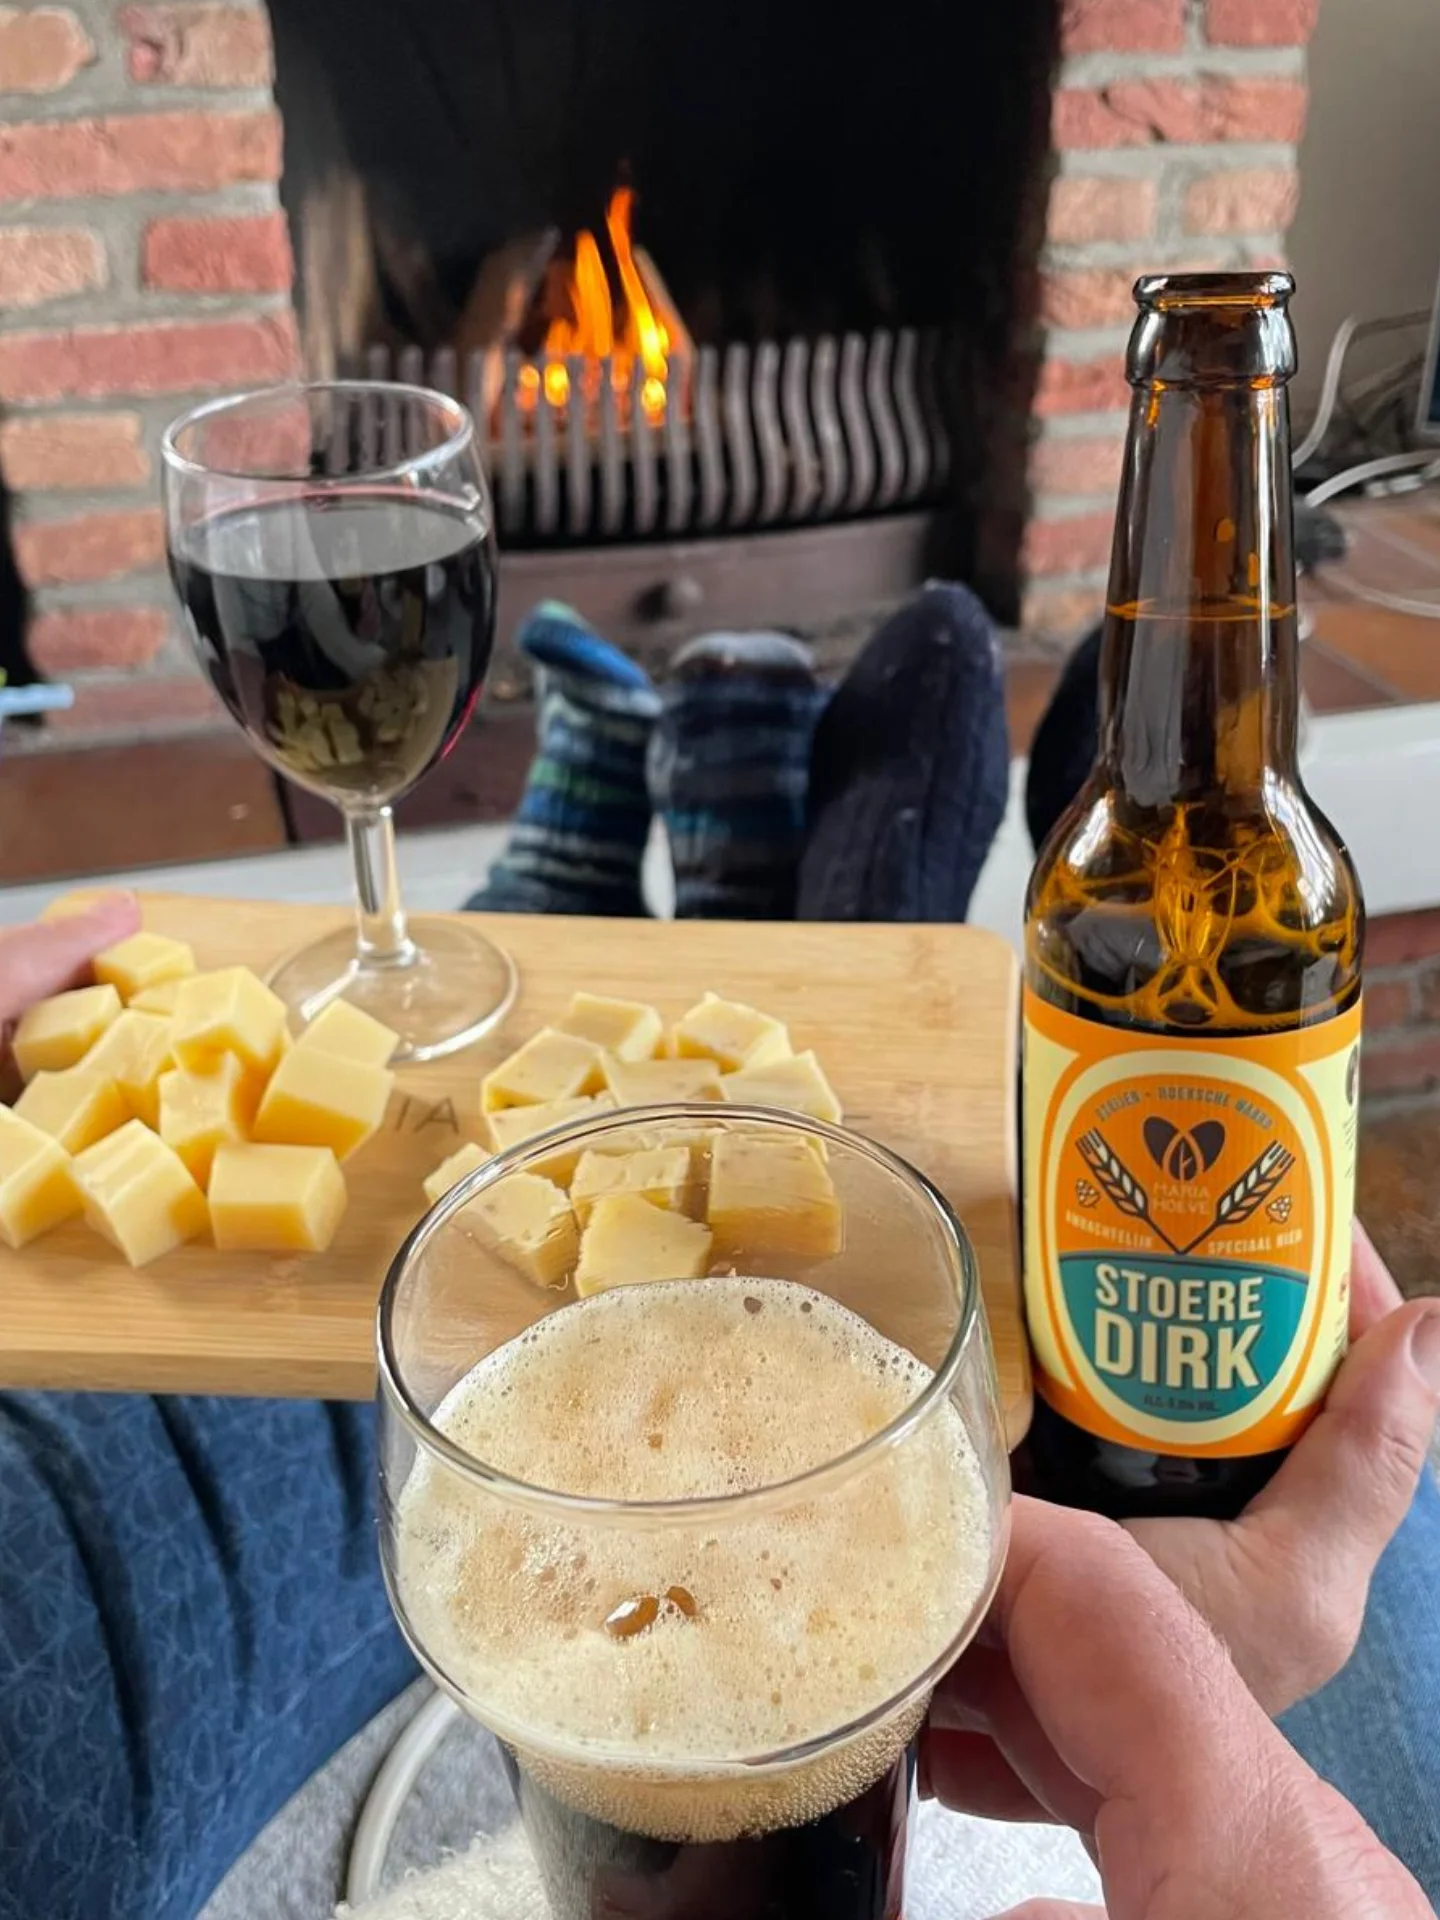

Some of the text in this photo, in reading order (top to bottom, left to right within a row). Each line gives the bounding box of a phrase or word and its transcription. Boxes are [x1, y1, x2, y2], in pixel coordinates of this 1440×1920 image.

[1153, 1180, 1210, 1198] MARIA
[1153, 1198, 1210, 1215] HOEVE
[1207, 1228, 1303, 1255] SPECIAAL BIER
[1094, 1263, 1264, 1322] STOERE
[1094, 1308, 1261, 1390] DIRK
